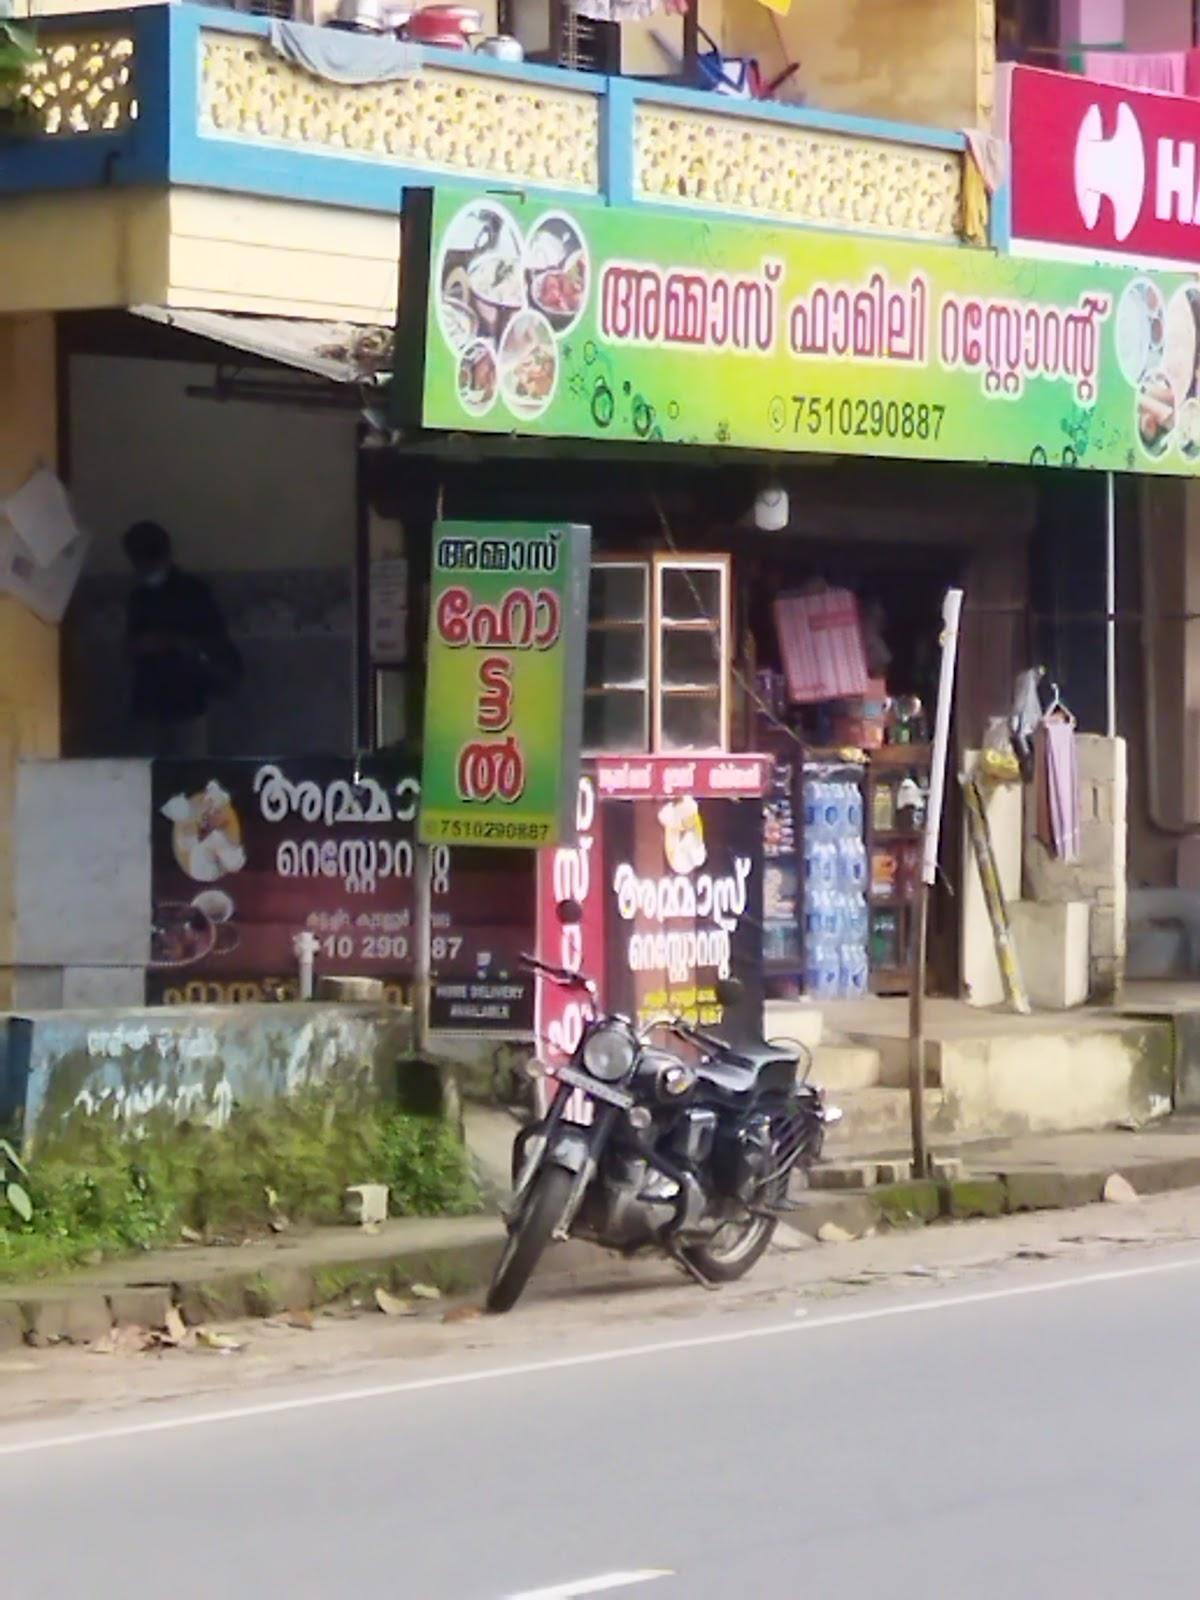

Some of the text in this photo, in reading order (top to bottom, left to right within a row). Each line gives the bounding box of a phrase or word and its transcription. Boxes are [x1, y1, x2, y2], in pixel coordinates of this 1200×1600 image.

[1155, 136, 1200, 227] H
[601, 262, 782, 351] അമ്മാസ്
[790, 273, 926, 362] ഫാമിലി
[791, 395, 946, 441] 7510290887
[437, 531, 561, 571] അമ്മാസ്
[440, 819, 549, 841] 7510290887
[360, 934, 409, 960] 290
